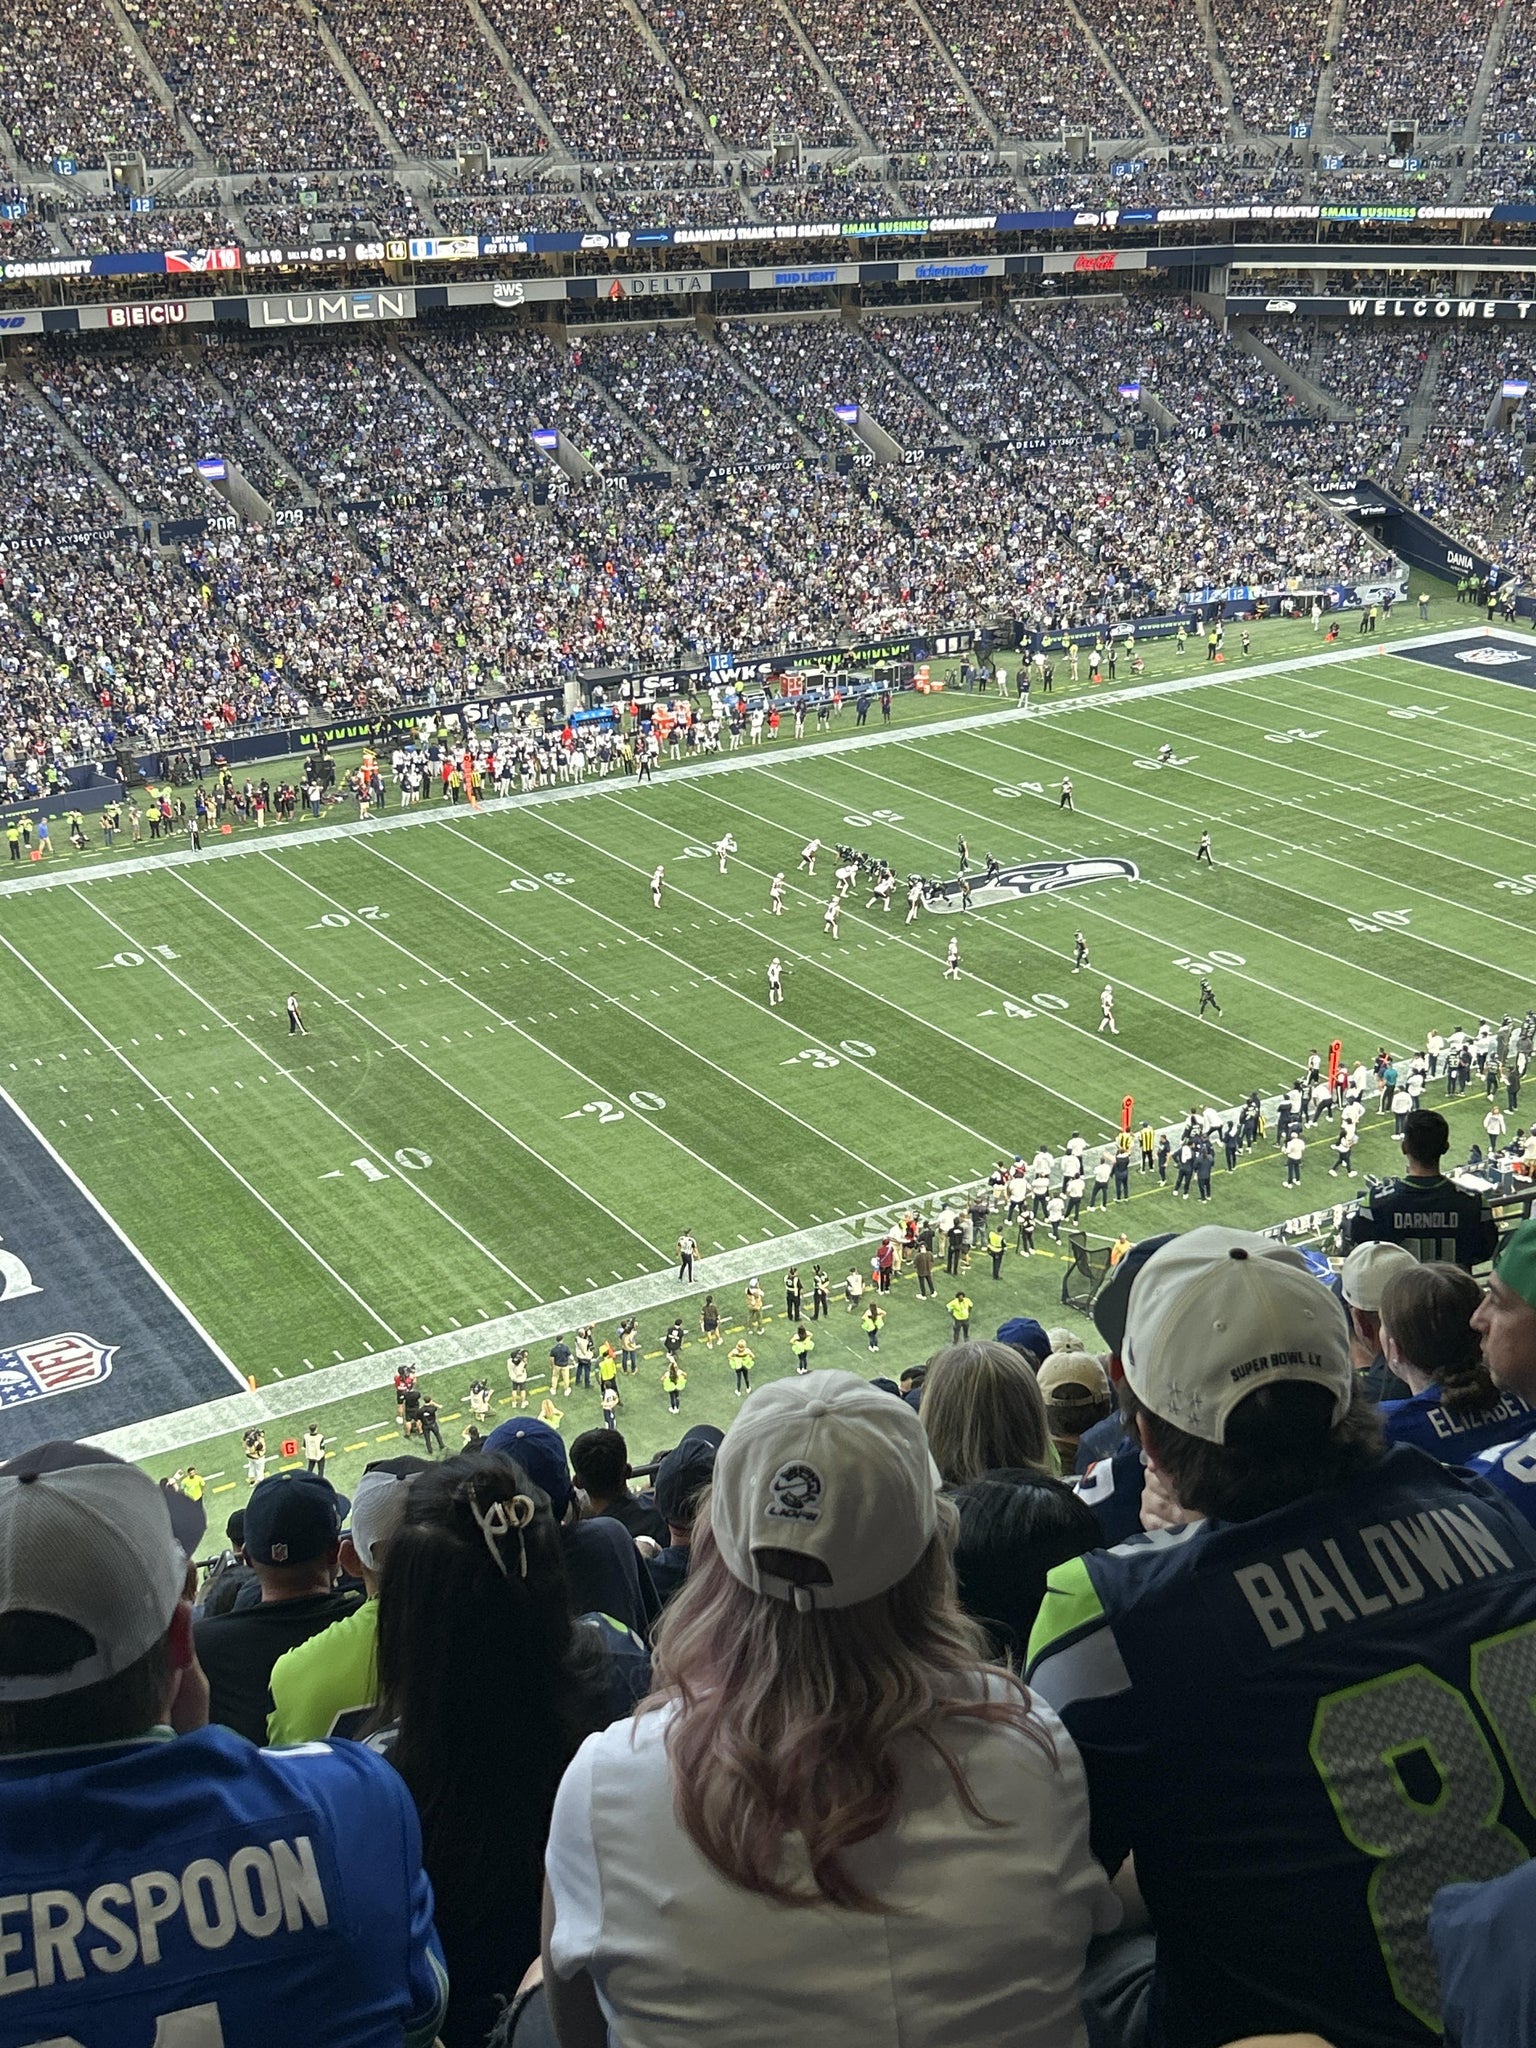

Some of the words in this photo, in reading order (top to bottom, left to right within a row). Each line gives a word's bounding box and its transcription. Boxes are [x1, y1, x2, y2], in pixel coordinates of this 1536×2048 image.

[1294, 126, 1308, 138] 12
[57, 160, 72, 175] 12
[1405, 160, 1418, 172] 12
[7, 205, 20, 219] 12
[136, 199, 150, 212] 12
[1320, 206, 1358, 217] SMALL
[1360, 206, 1416, 217] BUSINESS
[1417, 206, 1494, 219] COMMUNITY
[842, 222, 877, 234] SMALL
[878, 220, 928, 232] BUSINESS
[930, 217, 997, 231] COMMUNITY
[219, 250, 235, 268] 10
[5, 260, 92, 278] COMMUNITY
[775, 272, 800, 284] BUD
[801, 270, 836, 283] LIGHT
[915, 263, 989, 278] ticketmaster
[493, 284, 523, 298] aws
[632, 276, 702, 294] DELTA
[262, 293, 404, 325] LUMEN
[1349, 301, 1495, 318] WELCOME
[1016, 440, 1045, 449] DELTA
[905, 450, 924, 463] 212
[719, 466, 750, 476] DELTA
[548, 482, 570, 495] 20
[606, 477, 627, 490] 210
[1313, 481, 1357, 491] LUMEN
[207, 516, 236, 531] 208
[276, 509, 304, 526] 208
[11, 537, 52, 549] DELTA
[1447, 551, 1473, 570] DANIA
[714, 654, 728, 668] 12
[1347, 910, 1410, 932] 40
[1172, 950, 1247, 974] 50
[1003, 993, 1069, 1018] 40
[799, 1039, 877, 1068] 30
[582, 1090, 666, 1124] 20
[350, 1147, 433, 1182] 10
[1394, 1212, 1458, 1229] DARNOLD
[1230, 1356, 1269, 1382] SUPER
[1270, 1351, 1305, 1367] BOWL
[1308, 1351, 1322, 1368] LX
[1233, 1503, 1514, 1650] BALDWIN
[0, 1835, 329, 1997] ERSPOON
